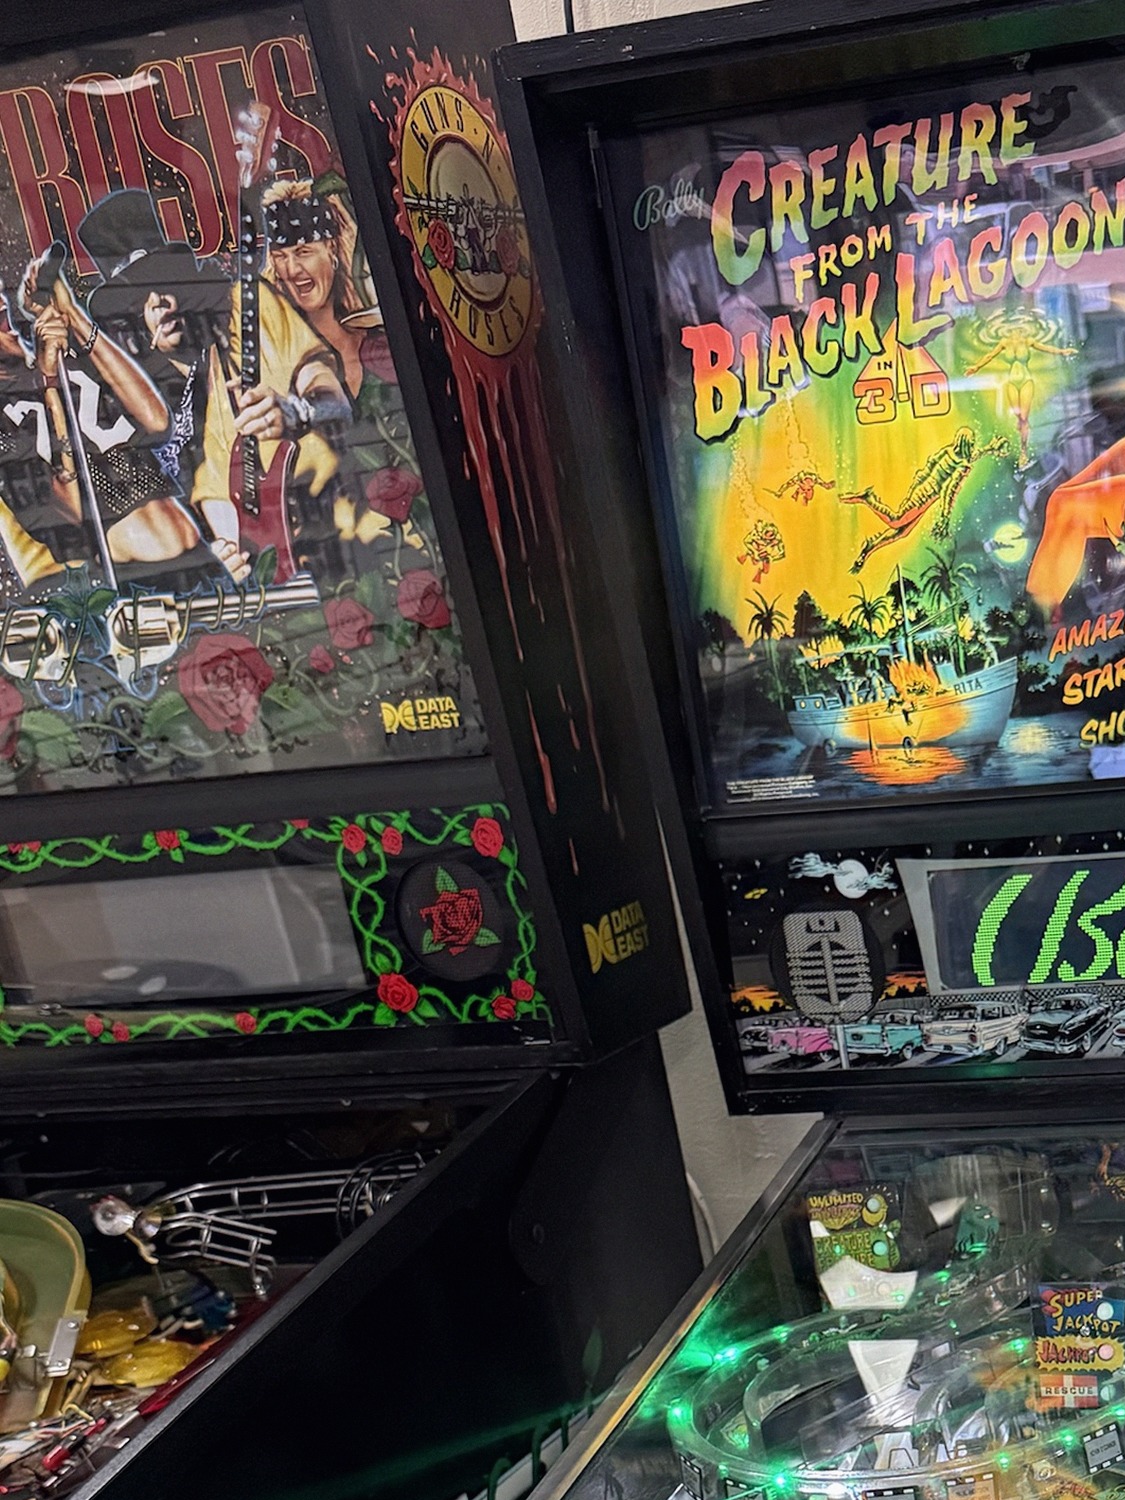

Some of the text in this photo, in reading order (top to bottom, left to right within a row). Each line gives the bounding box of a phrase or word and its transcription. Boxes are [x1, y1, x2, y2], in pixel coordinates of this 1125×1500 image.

[410, 92, 464, 152] GUNS
[0, 34, 335, 276] ROSES
[633, 177, 704, 231] Bally
[710, 92, 1036, 286] CREATURE
[790, 193, 979, 304] FROM THE
[681, 272, 882, 446] BLACK
[876, 360, 893, 372] IN
[855, 373, 951, 424] 3-D
[953, 678, 983, 696] RITA
[415, 696, 457, 714] DATA
[418, 711, 461, 730] EAST
[611, 902, 643, 933] DATA
[614, 930, 649, 964] EAST
[1049, 1290, 1103, 1318] SUPER
[1053, 1313, 1120, 1333] JACKPOT
[1045, 1387, 1093, 1395] RESCUE
